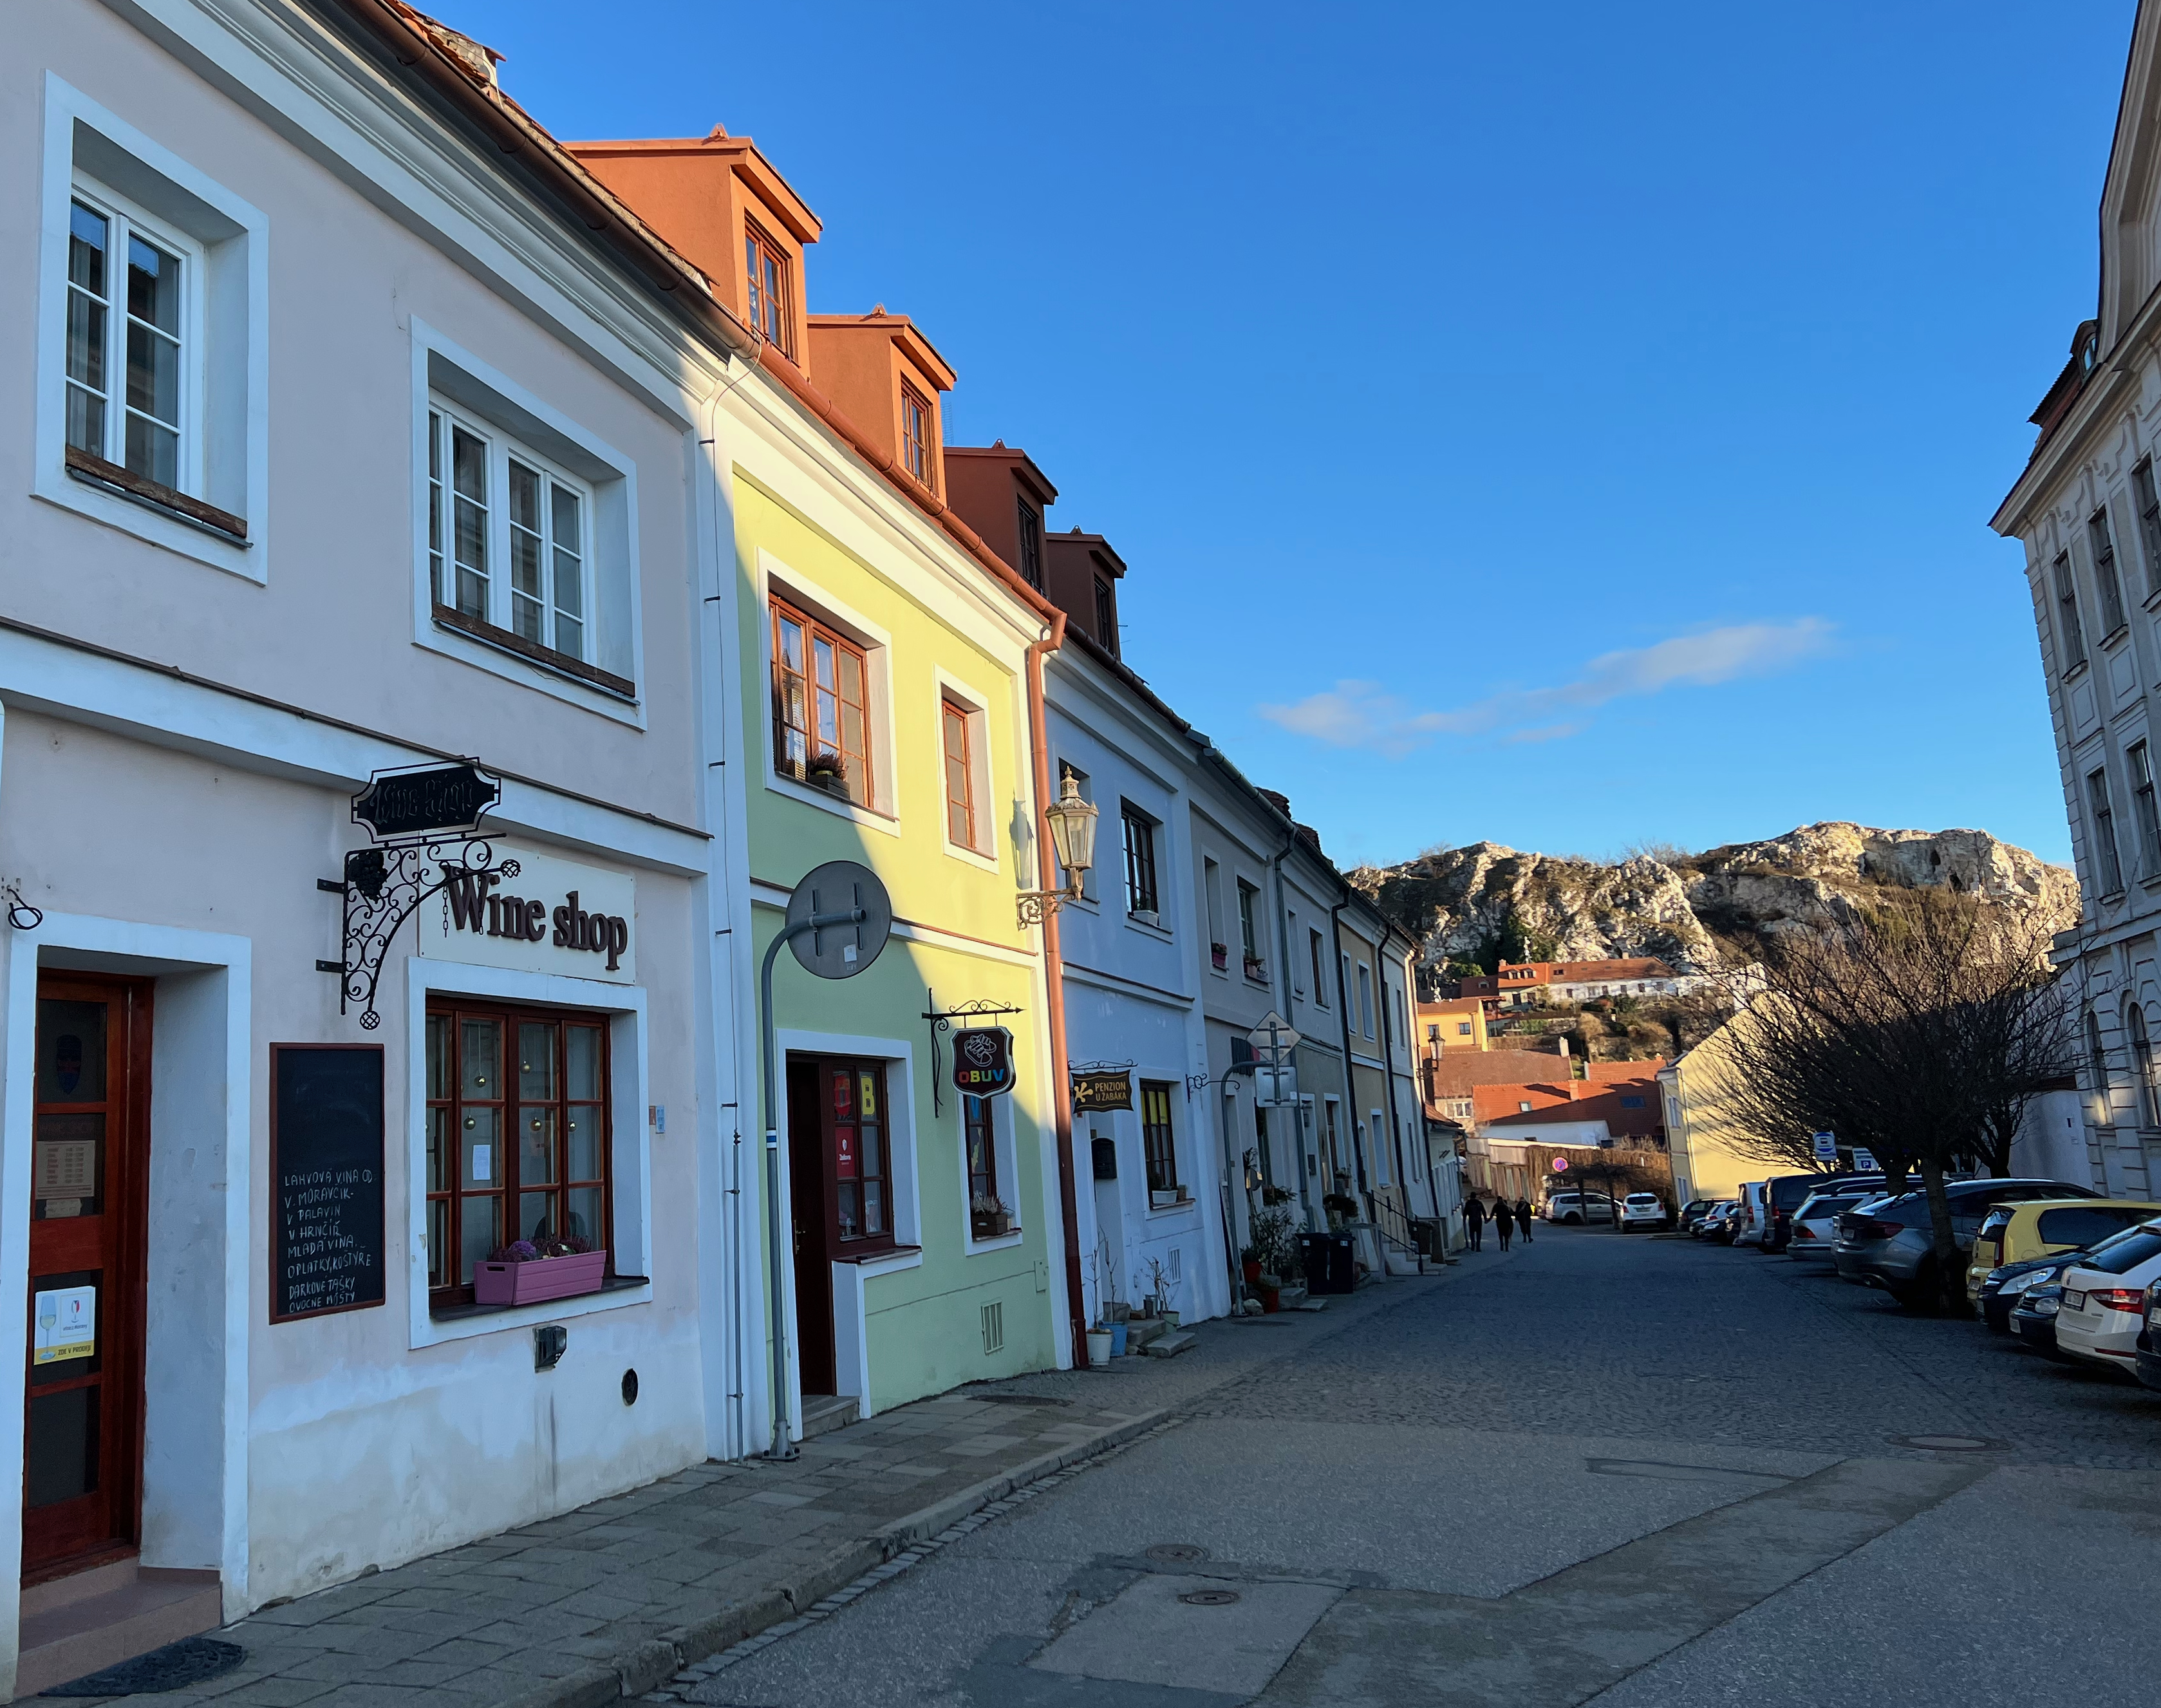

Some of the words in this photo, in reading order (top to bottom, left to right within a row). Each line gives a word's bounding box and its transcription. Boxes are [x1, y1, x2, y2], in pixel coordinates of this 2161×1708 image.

[438, 865, 546, 941] Wine
[553, 890, 628, 970] shop
[959, 1069, 1004, 1084] OBUV
[1095, 1082, 1126, 1092] PENZION
[1096, 1093, 1101, 1102] U
